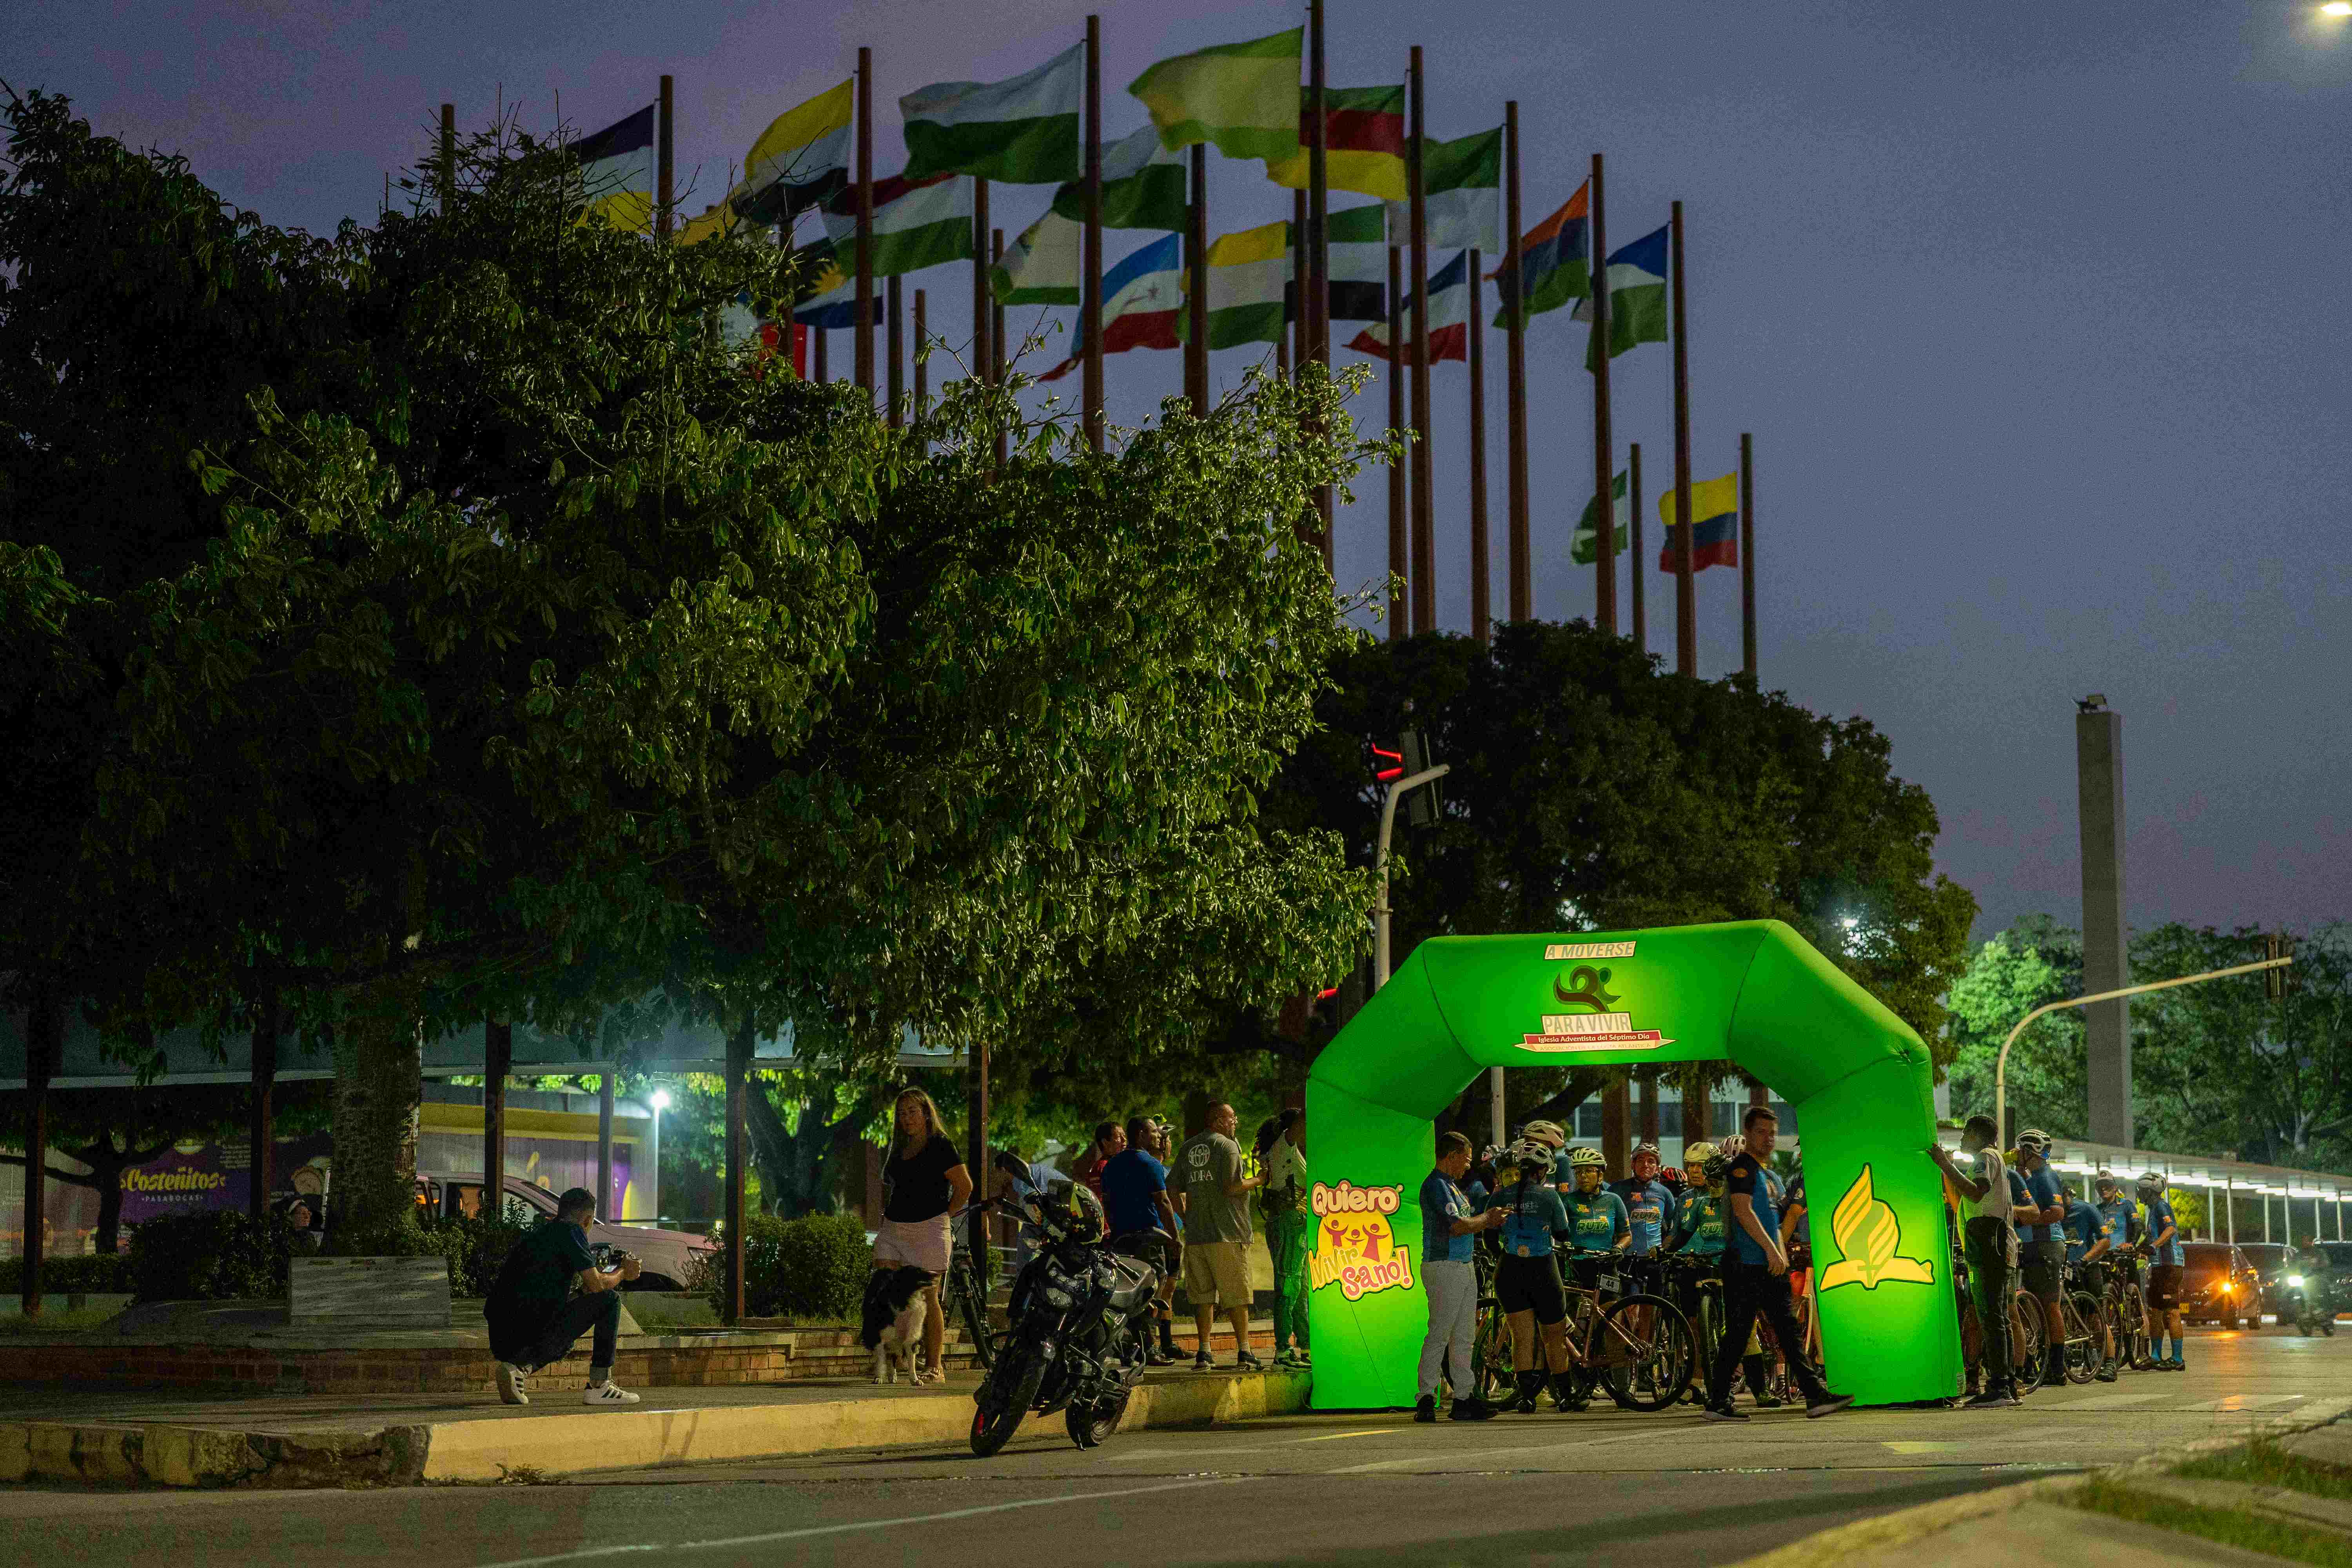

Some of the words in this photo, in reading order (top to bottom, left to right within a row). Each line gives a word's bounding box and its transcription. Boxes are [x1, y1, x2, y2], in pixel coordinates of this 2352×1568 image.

[1546, 945, 1555, 958] A
[1561, 942, 1633, 957] MOVERSE
[1544, 1016, 1585, 1033] PARA
[1587, 1014, 1630, 1031] VIVIR
[127, 1167, 220, 1191] Costeñitos
[1189, 1170, 1214, 1183] ADRA
[1312, 1183, 1397, 1215] Quiero
[1577, 1220, 1609, 1230] RUTA
[1606, 1280, 1614, 1288] 44
